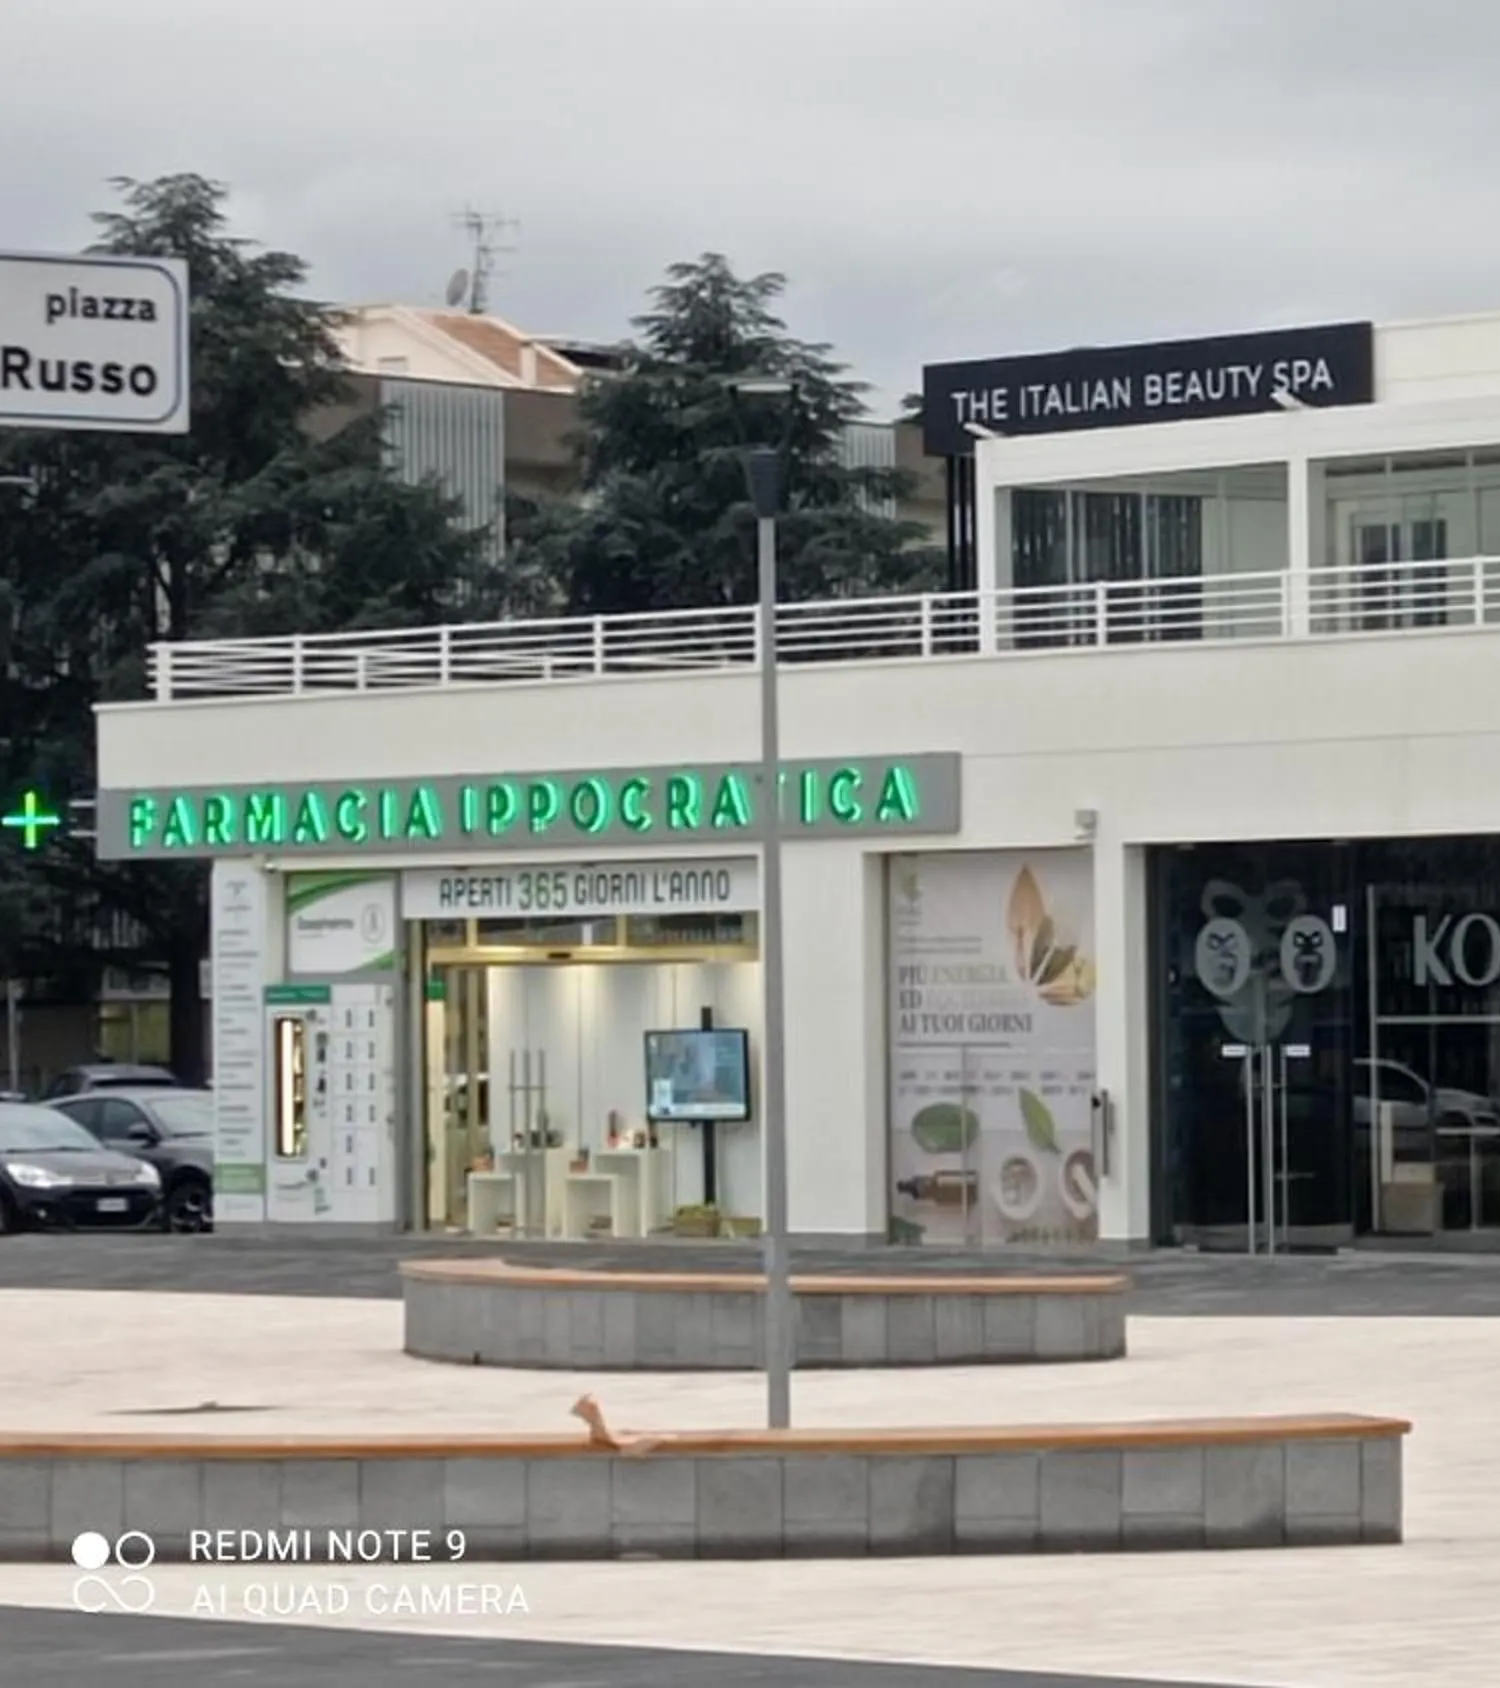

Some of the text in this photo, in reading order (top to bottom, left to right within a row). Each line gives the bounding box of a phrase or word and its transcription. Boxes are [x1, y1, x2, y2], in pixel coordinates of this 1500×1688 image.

[46, 287, 157, 324] piazza
[1, 346, 158, 396] Russo
[951, 358, 1334, 424] THE ITALIAN BEAUTY SPA
[128, 764, 920, 849] FARMACIA IPPOCRAICA
[440, 868, 731, 911] APERTI 365 GIORNI L'ANNO
[898, 988, 923, 1009] ED
[920, 1012, 965, 1035] TUOI
[967, 1012, 1034, 1035] GIORNI
